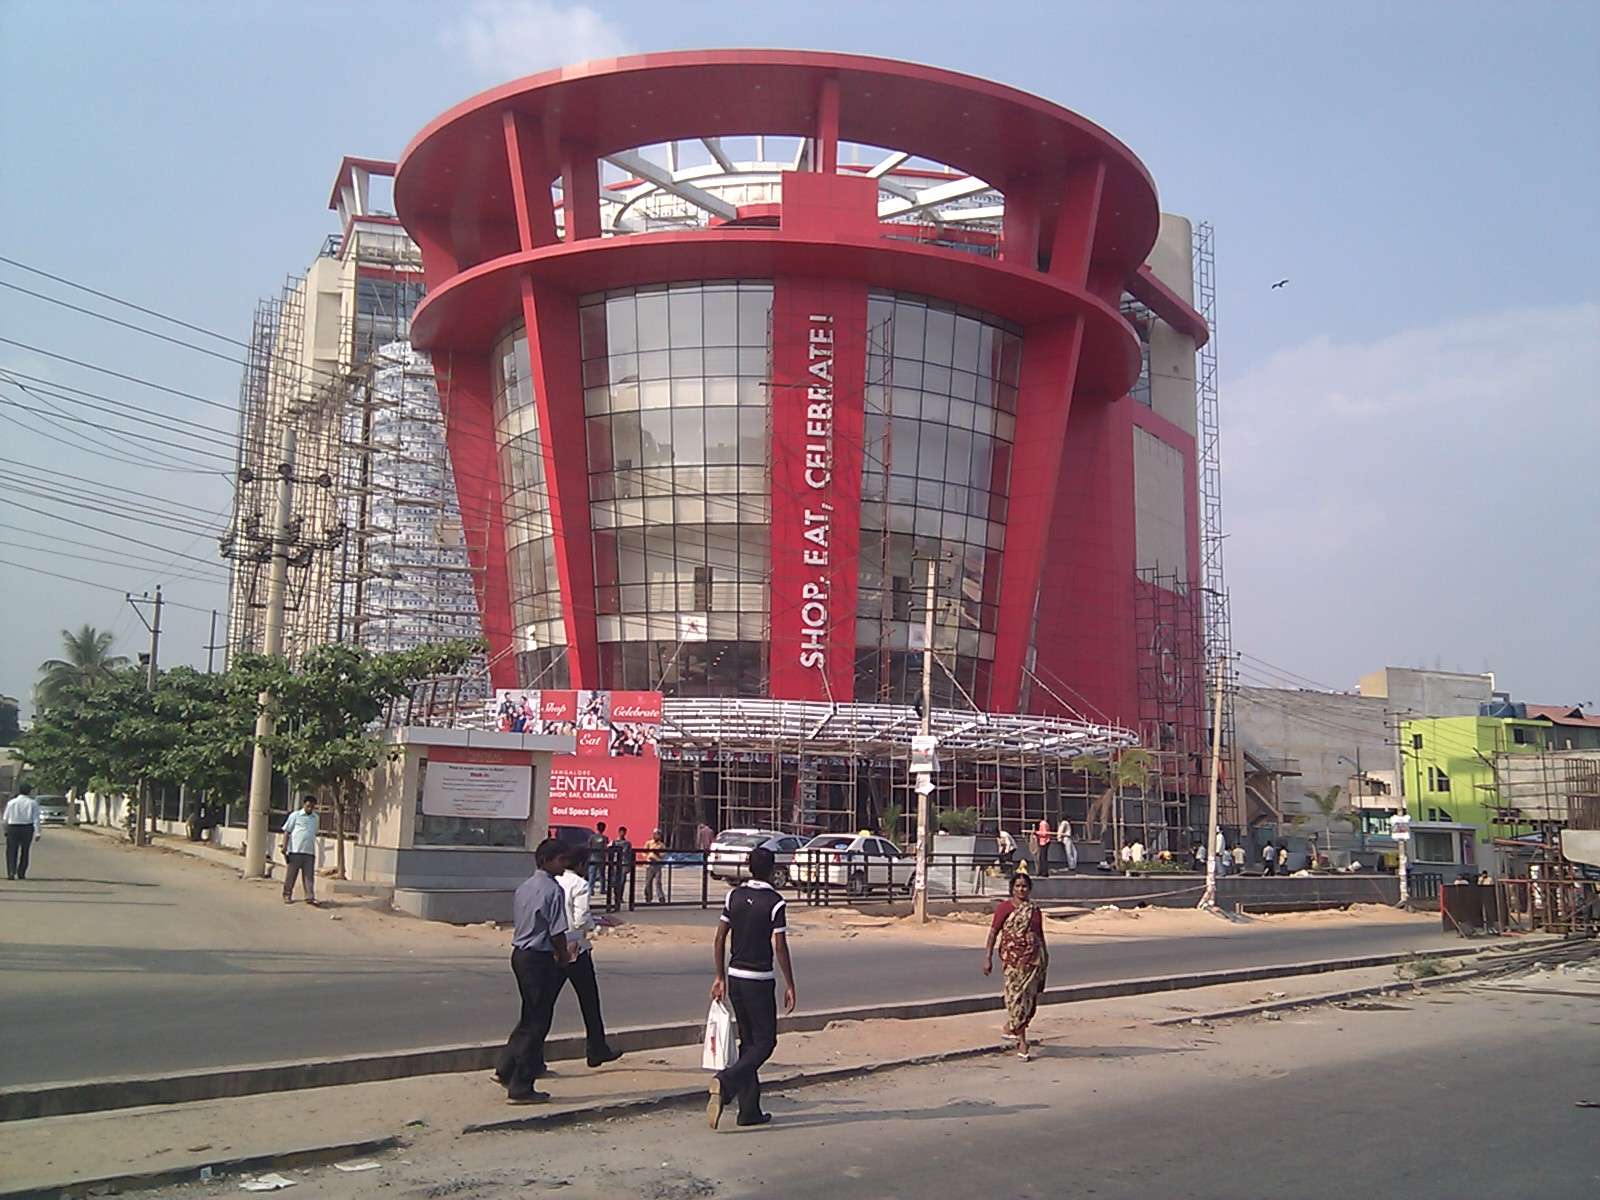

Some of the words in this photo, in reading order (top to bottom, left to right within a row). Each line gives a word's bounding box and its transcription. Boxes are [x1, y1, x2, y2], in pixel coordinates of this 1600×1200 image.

[804, 314, 835, 490] CELEBRATE!
[803, 502, 834, 566] EAT,
[541, 702, 567, 716] Shop
[613, 706, 660, 718] Celebrate
[579, 733, 602, 746] Eat
[552, 806, 568, 815] Soul
[568, 806, 589, 816] Space
[590, 807, 609, 817] Spirit
